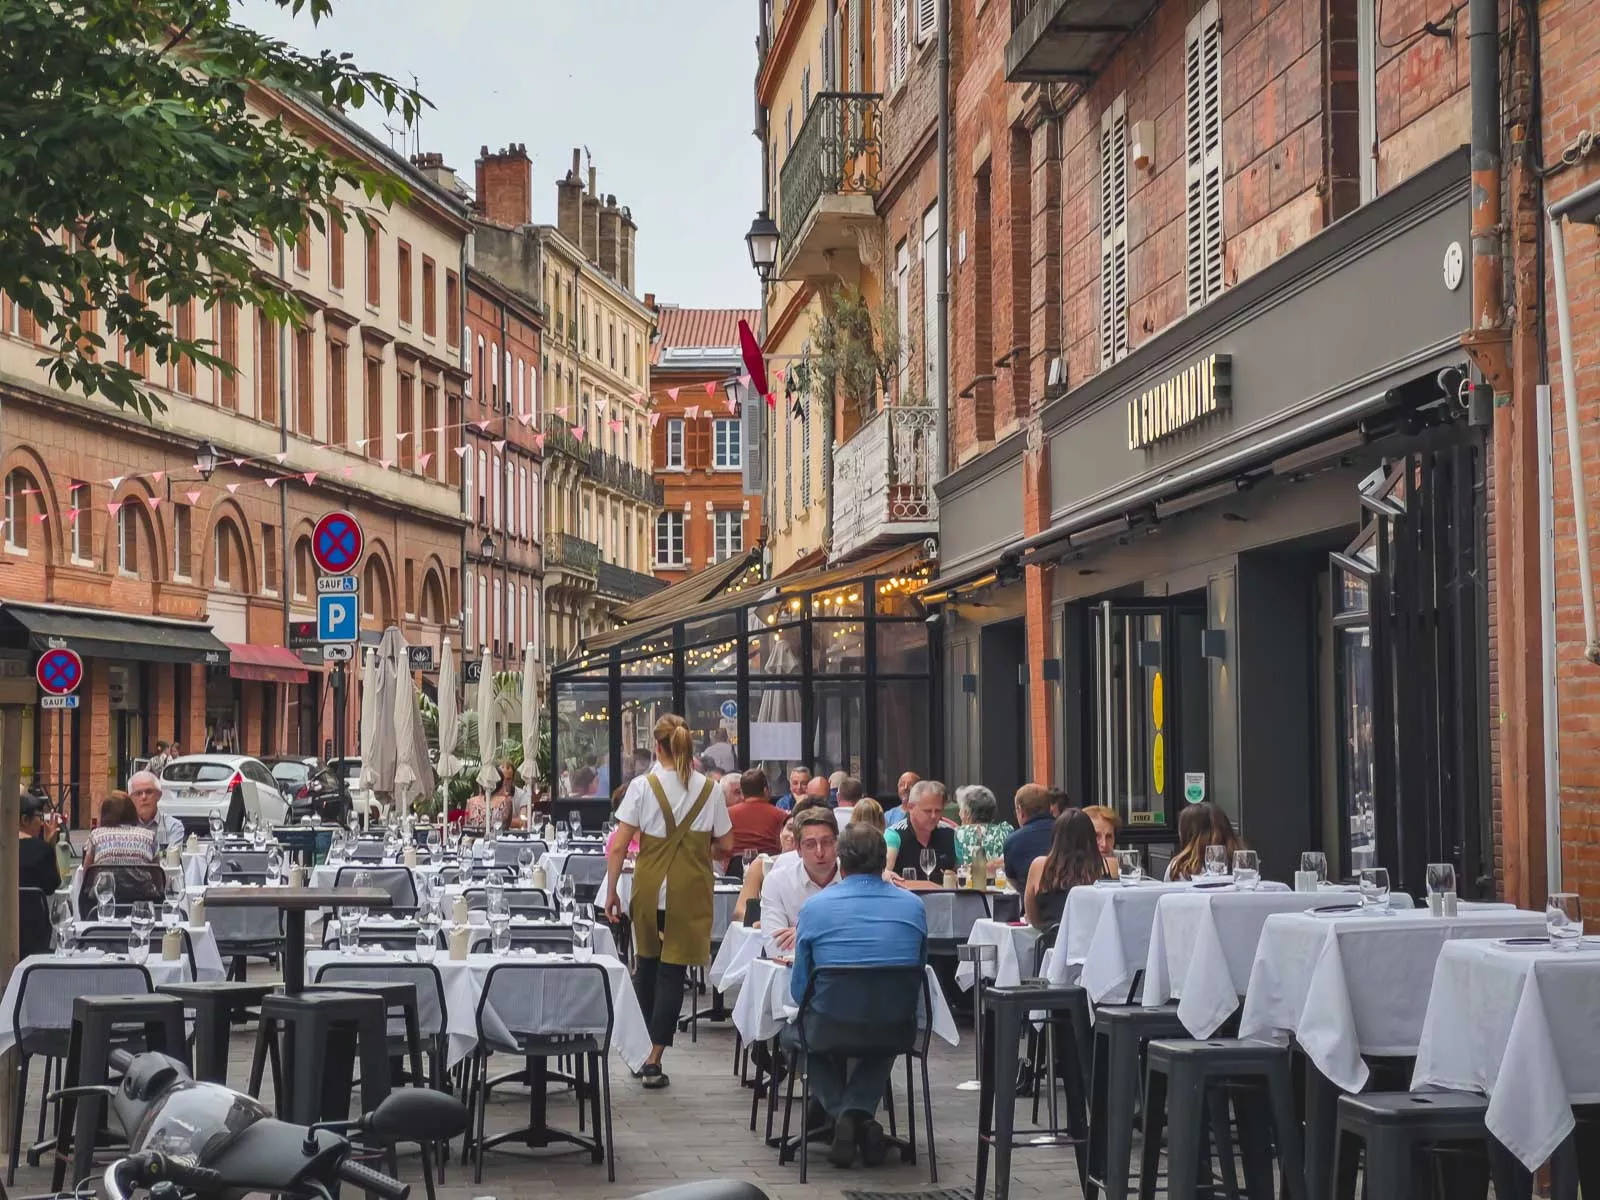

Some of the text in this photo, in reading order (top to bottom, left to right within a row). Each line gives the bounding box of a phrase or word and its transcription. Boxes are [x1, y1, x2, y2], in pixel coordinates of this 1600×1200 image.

[1127, 353, 1217, 451] LA GOURMANDINE
[319, 579, 341, 589] SAUF
[328, 603, 346, 633] P
[43, 698, 64, 706] SAUF
